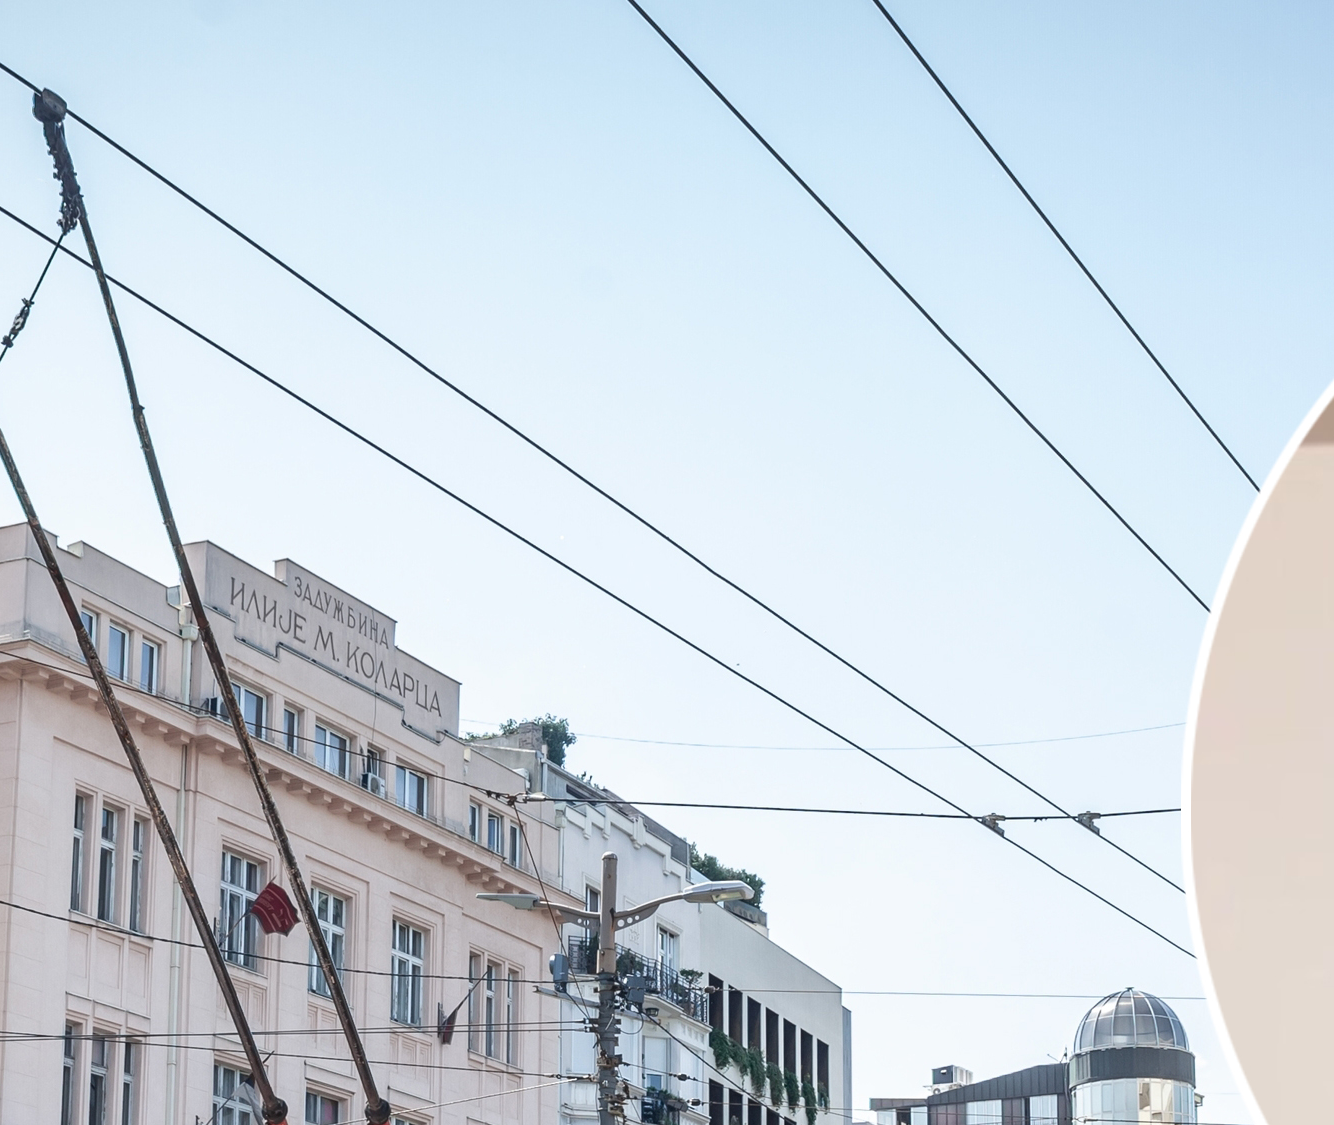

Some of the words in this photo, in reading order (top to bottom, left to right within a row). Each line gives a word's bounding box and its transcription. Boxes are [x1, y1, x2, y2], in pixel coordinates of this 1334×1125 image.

[230, 577, 307, 644] ИЛИЈЕ
[346, 640, 443, 718] КОЛАРЦА
[293, 576, 390, 649] ЗАДУЖБИНА
